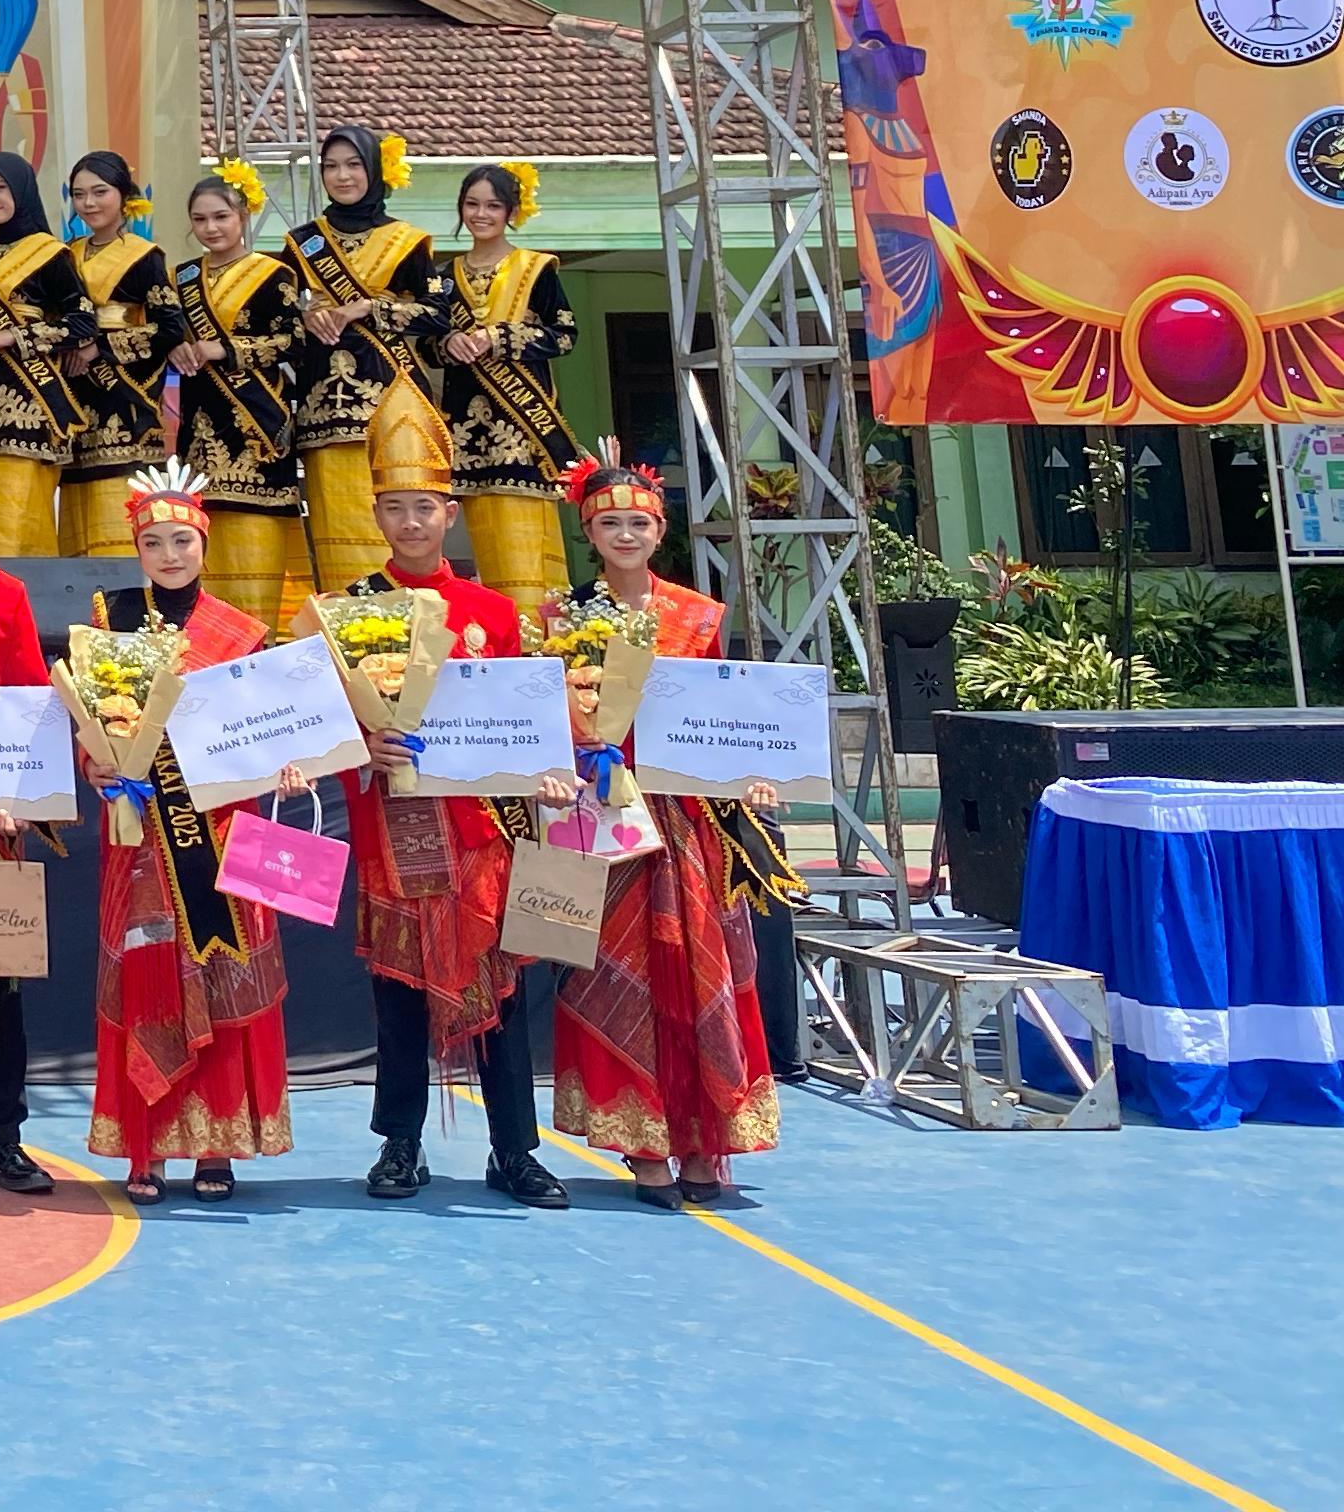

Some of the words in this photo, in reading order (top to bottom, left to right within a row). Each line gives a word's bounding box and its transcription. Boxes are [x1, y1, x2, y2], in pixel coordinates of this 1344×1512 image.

[1207, 10, 1231, 42] SMA
[1229, 37, 1290, 60] NEGERI
[1294, 47, 1304, 59] 2
[1012, 110, 1048, 127] SMANDA
[1014, 194, 1045, 208] TODAY
[1147, 187, 1188, 200] Adipati
[1191, 187, 1214, 201] Ayu
[21, 357, 55, 387] 2024
[525, 402, 557, 437] 2024
[221, 717, 244, 737] Ayu
[245, 704, 296, 728] Berbakat
[420, 716, 462, 732] Adipati
[464, 716, 533, 732] Lingkungan
[682, 716, 707, 732] Ayu
[709, 718, 780, 735] Lingkungan
[667, 732, 701, 746] SMAN
[706, 735, 714, 746] 2
[716, 735, 763, 752] Malang
[767, 739, 797, 752] 2025
[16, 759, 44, 771] 2025
[168, 801, 203, 848] 2025
[263, 858, 302, 881] emina
[516, 887, 598, 920] Caroline
